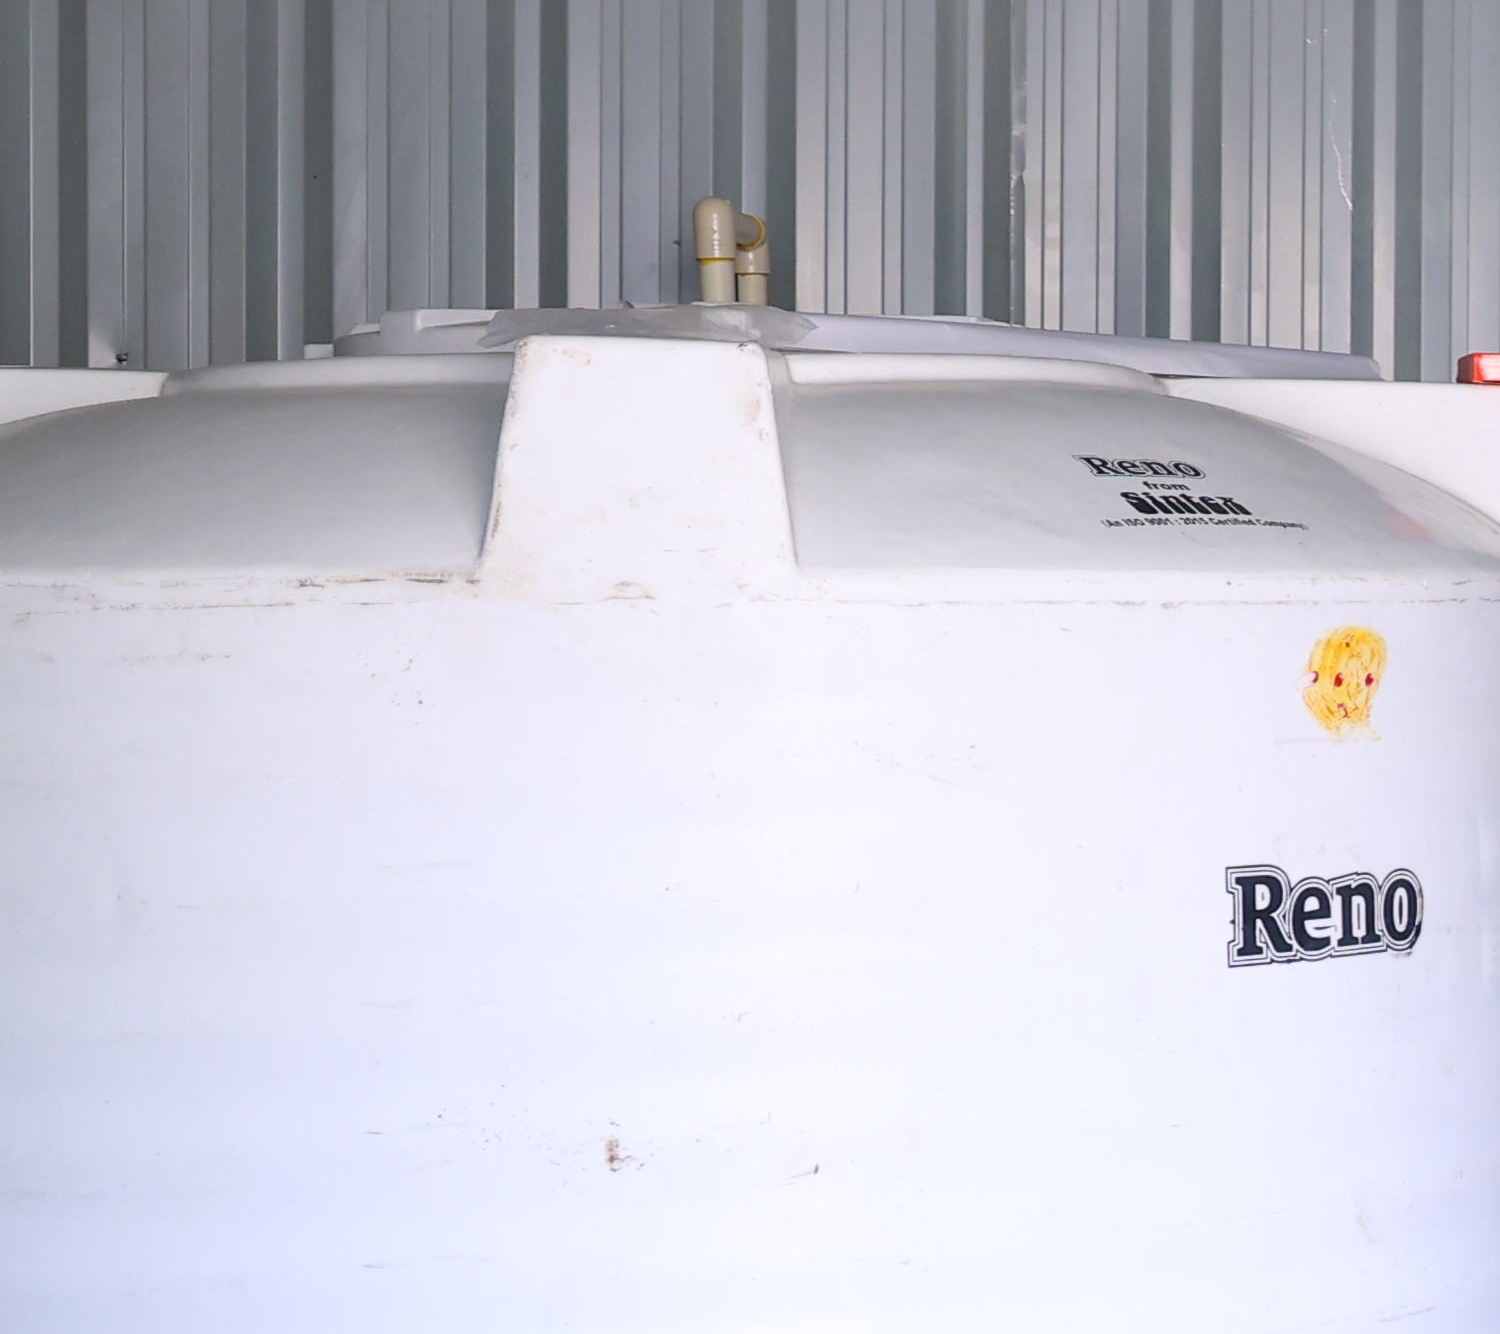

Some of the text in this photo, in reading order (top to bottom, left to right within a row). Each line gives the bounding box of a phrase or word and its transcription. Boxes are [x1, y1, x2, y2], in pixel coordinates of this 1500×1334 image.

[1073, 454, 1206, 479] Reno
[1142, 480, 1190, 491] from
[1119, 491, 1252, 516] Sintex
[1126, 518, 1145, 527] ISO
[1149, 518, 1171, 527] 9001
[1211, 518, 1255, 527] Certified
[1226, 864, 1423, 968] Reno
